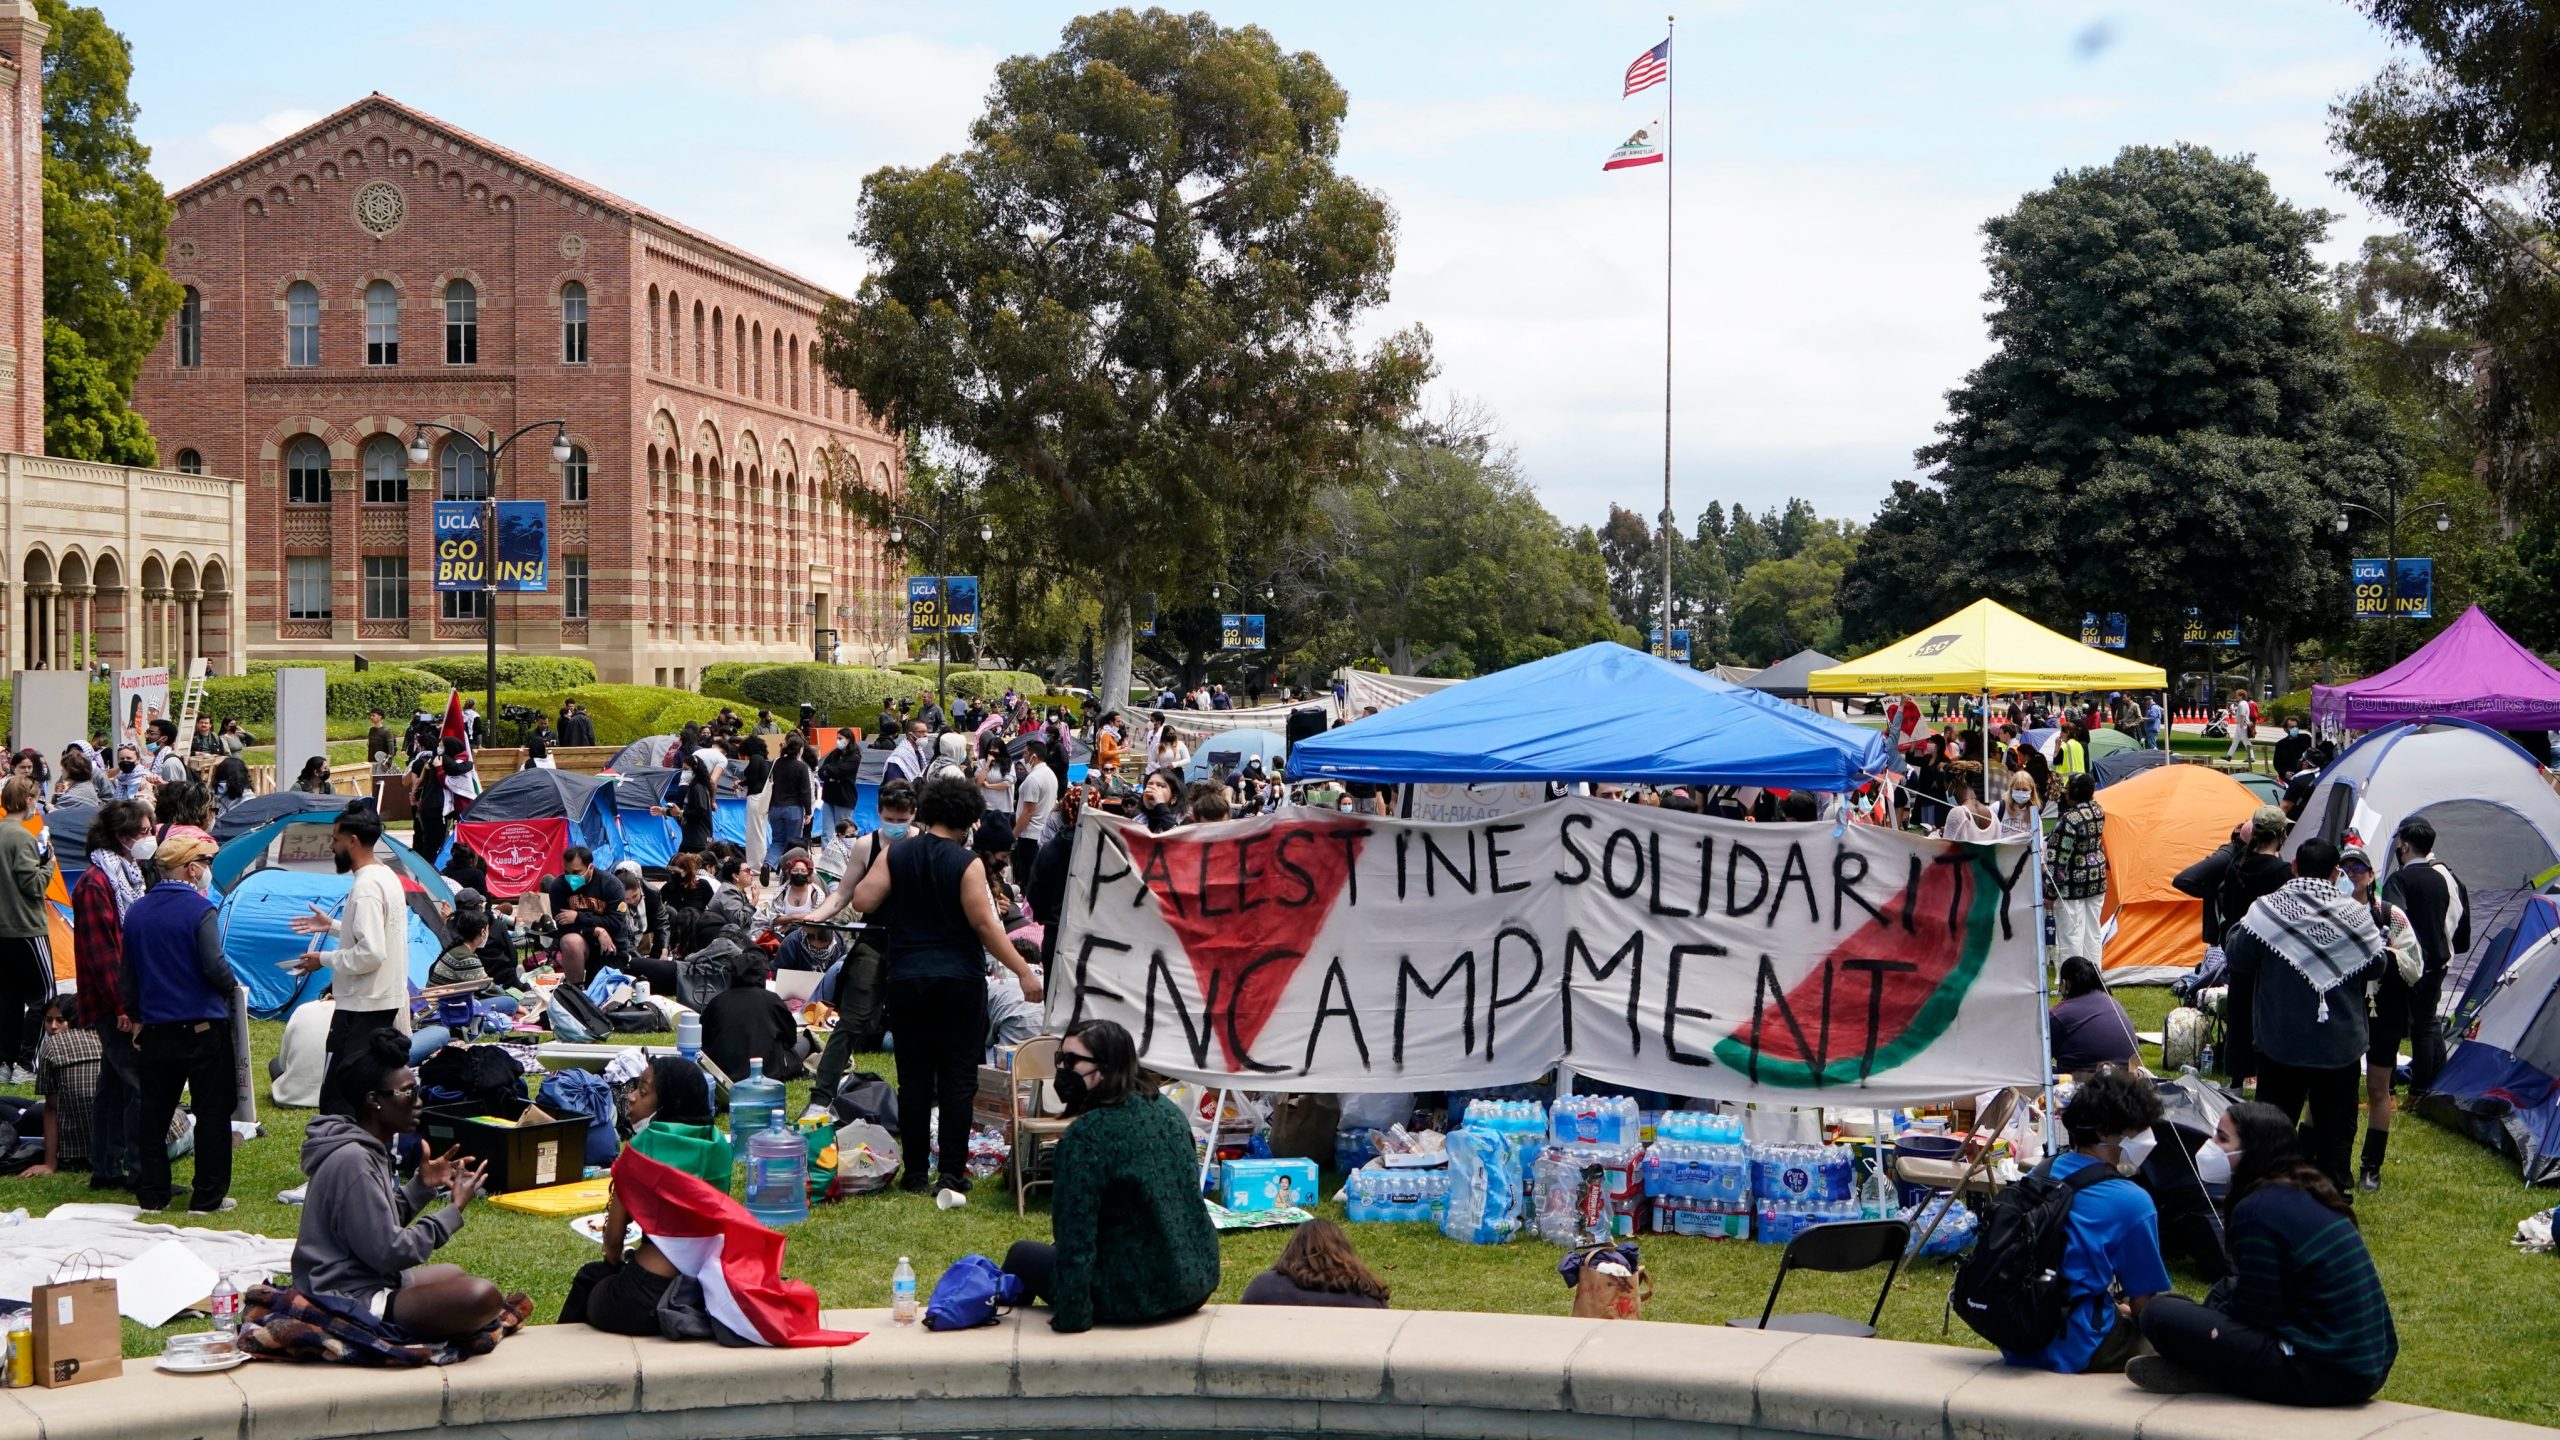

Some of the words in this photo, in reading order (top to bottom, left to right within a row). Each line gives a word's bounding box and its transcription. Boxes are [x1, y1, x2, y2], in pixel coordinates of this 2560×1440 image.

[438, 515, 480, 529] UCLA
[440, 539, 478, 560] GO
[2355, 567, 2385, 577] UCLA
[912, 585, 937, 595] UCLA
[2355, 584, 2383, 598] GO
[912, 601, 935, 614] GO
[1223, 629, 1239, 637] GO
[2082, 627, 2098, 636] GO
[141, 673, 168, 687] STRUGGLE
[1900, 675, 1934, 683] Commission
[2038, 673, 2060, 681] Campus
[2351, 698, 2446, 713] CULTURAL
[2451, 699, 2526, 713] AFFAIRS
[1089, 824, 1532, 919] PALESTINE
[1554, 814, 2032, 941] SOLIDARITY
[1786, 1170, 1805, 1179] Pure
[1789, 1176, 1803, 1186] Life
[1681, 1212, 1700, 1220] CRYSTAL
